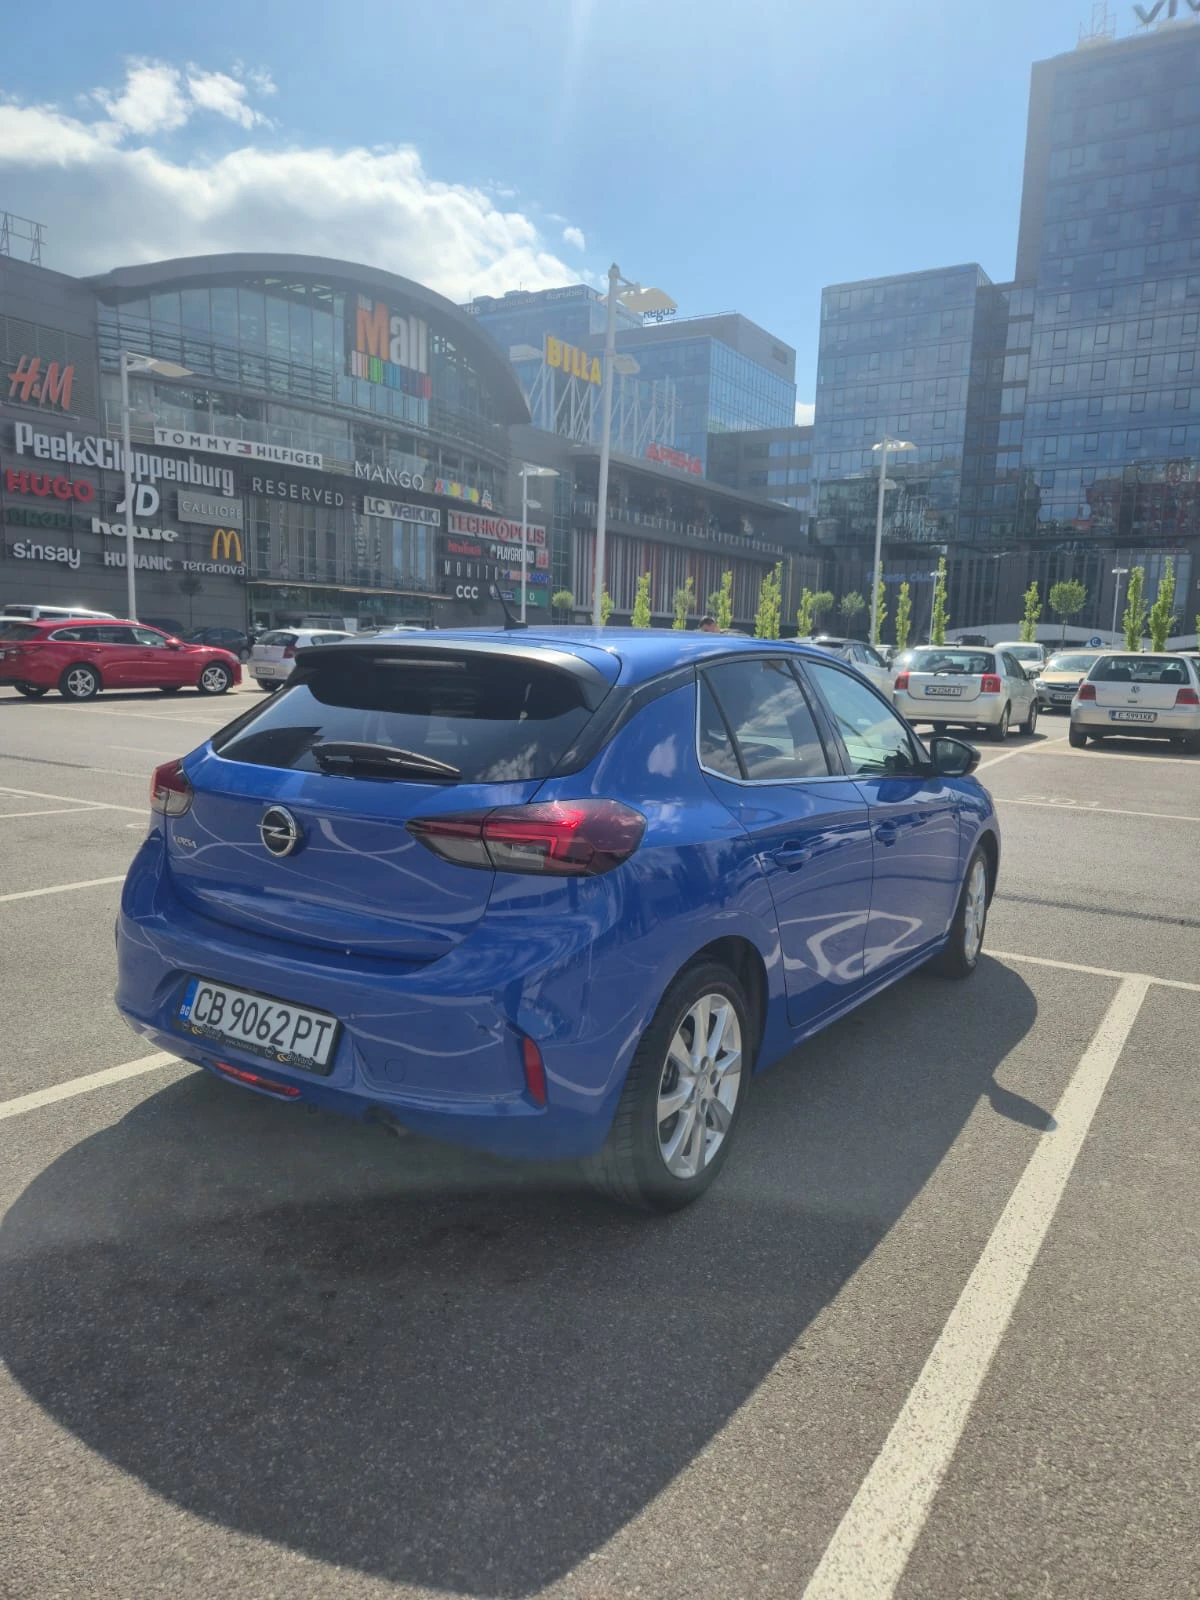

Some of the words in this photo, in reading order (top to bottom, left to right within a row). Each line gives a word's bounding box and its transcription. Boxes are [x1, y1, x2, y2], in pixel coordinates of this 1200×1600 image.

[356, 302, 427, 374] Mall
[546, 334, 601, 386] BILLA
[8, 355, 74, 411] H&M
[158, 430, 231, 452] TOMMY
[256, 445, 320, 467] HILFIGER
[6, 467, 95, 503] HUGO
[354, 460, 424, 491] MANGO
[252, 477, 345, 507] RESERVED
[368, 498, 386, 514] LC
[182, 501, 242, 520] CALLIOPE
[91, 517, 178, 542] house
[13, 539, 81, 569] sinsay
[496, 546, 534, 564] PLAYGROND
[456, 585, 479, 600] CCC
[179, 1004, 191, 1016] BG
